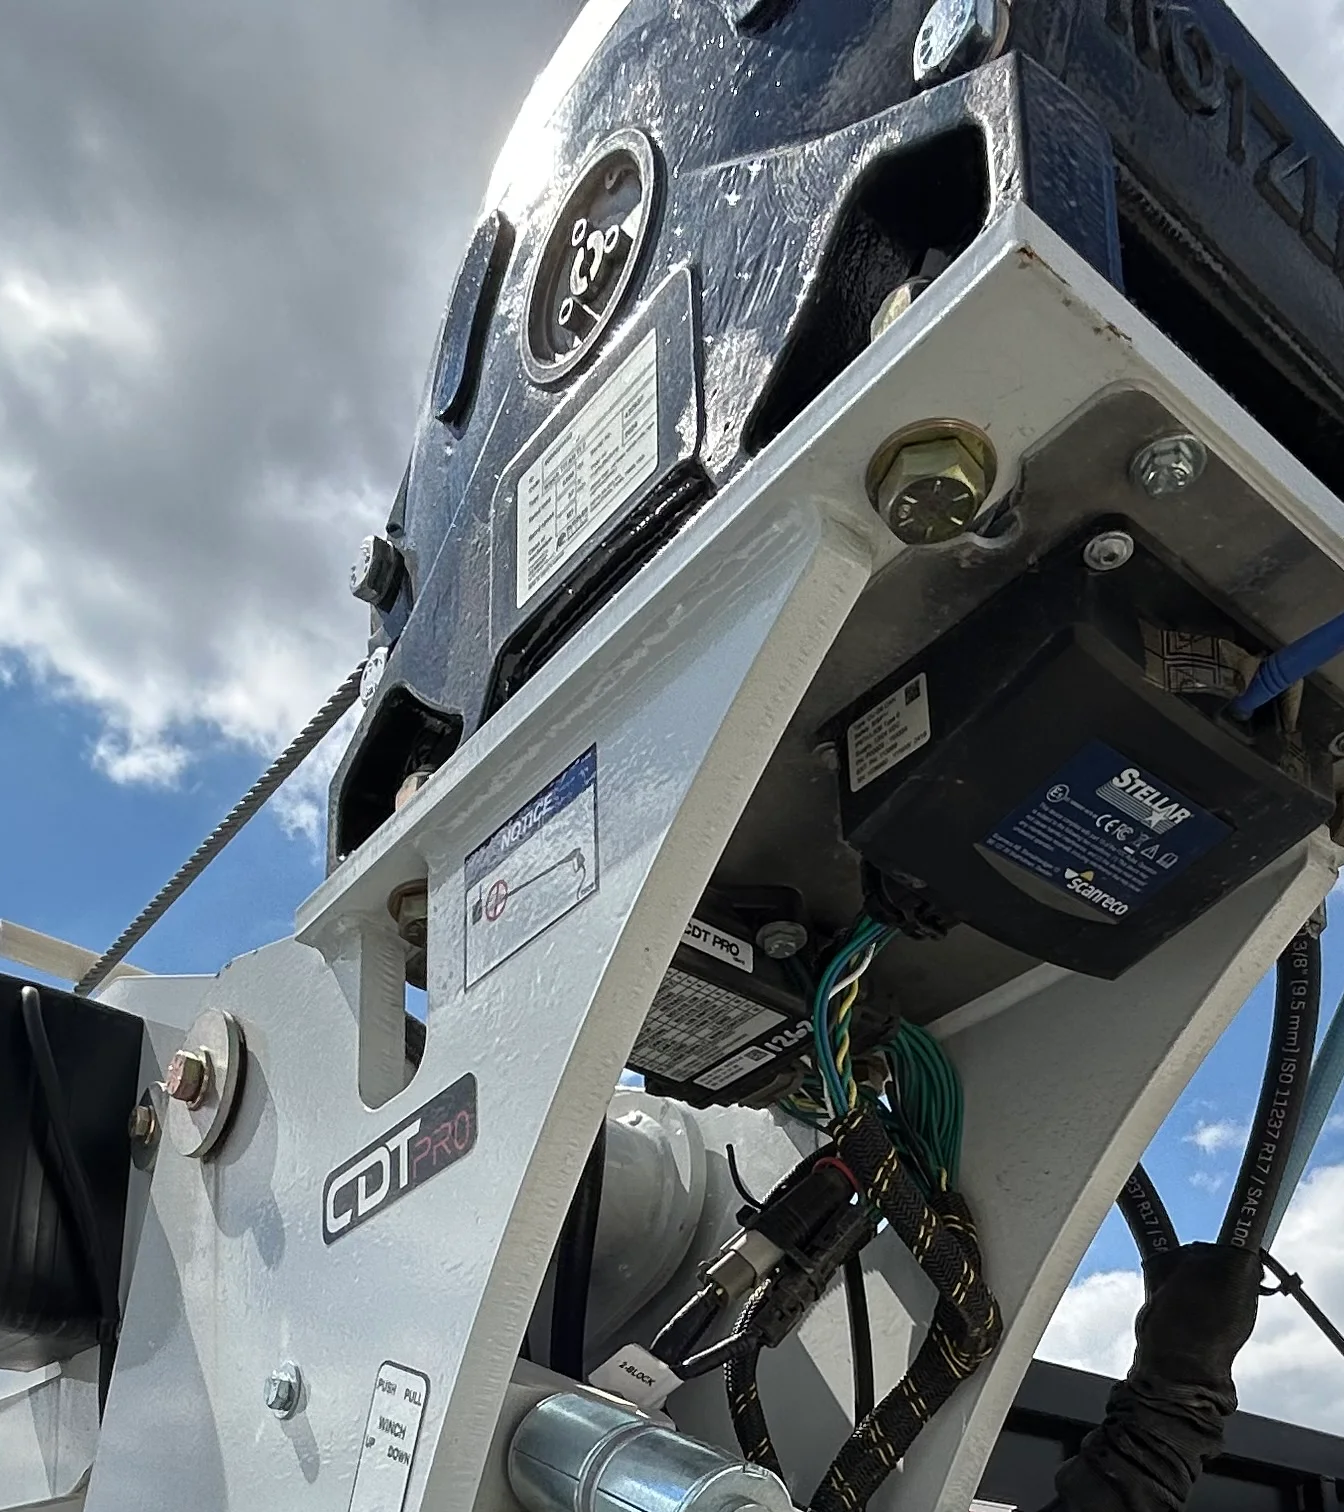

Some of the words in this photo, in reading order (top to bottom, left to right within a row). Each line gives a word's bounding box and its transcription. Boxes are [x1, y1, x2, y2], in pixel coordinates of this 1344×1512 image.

[1112, 768, 1192, 824] STELLAR
[500, 792, 555, 851] NOTICE
[1067, 876, 1128, 916] scanreco
[712, 934, 740, 957] PRO
[1278, 1058, 1297, 1084] ISO
[1266, 1088, 1291, 1140] 11237
[1256, 1141, 1277, 1174] R17
[1137, 1201, 1160, 1225] R17
[1240, 1186, 1263, 1217] SAE
[377, 1377, 397, 1396] PUSH
[404, 1387, 422, 1407] PULL
[378, 1416, 406, 1440] WINCH
[365, 1436, 375, 1449] UP
[387, 1447, 410, 1467] DOWN
